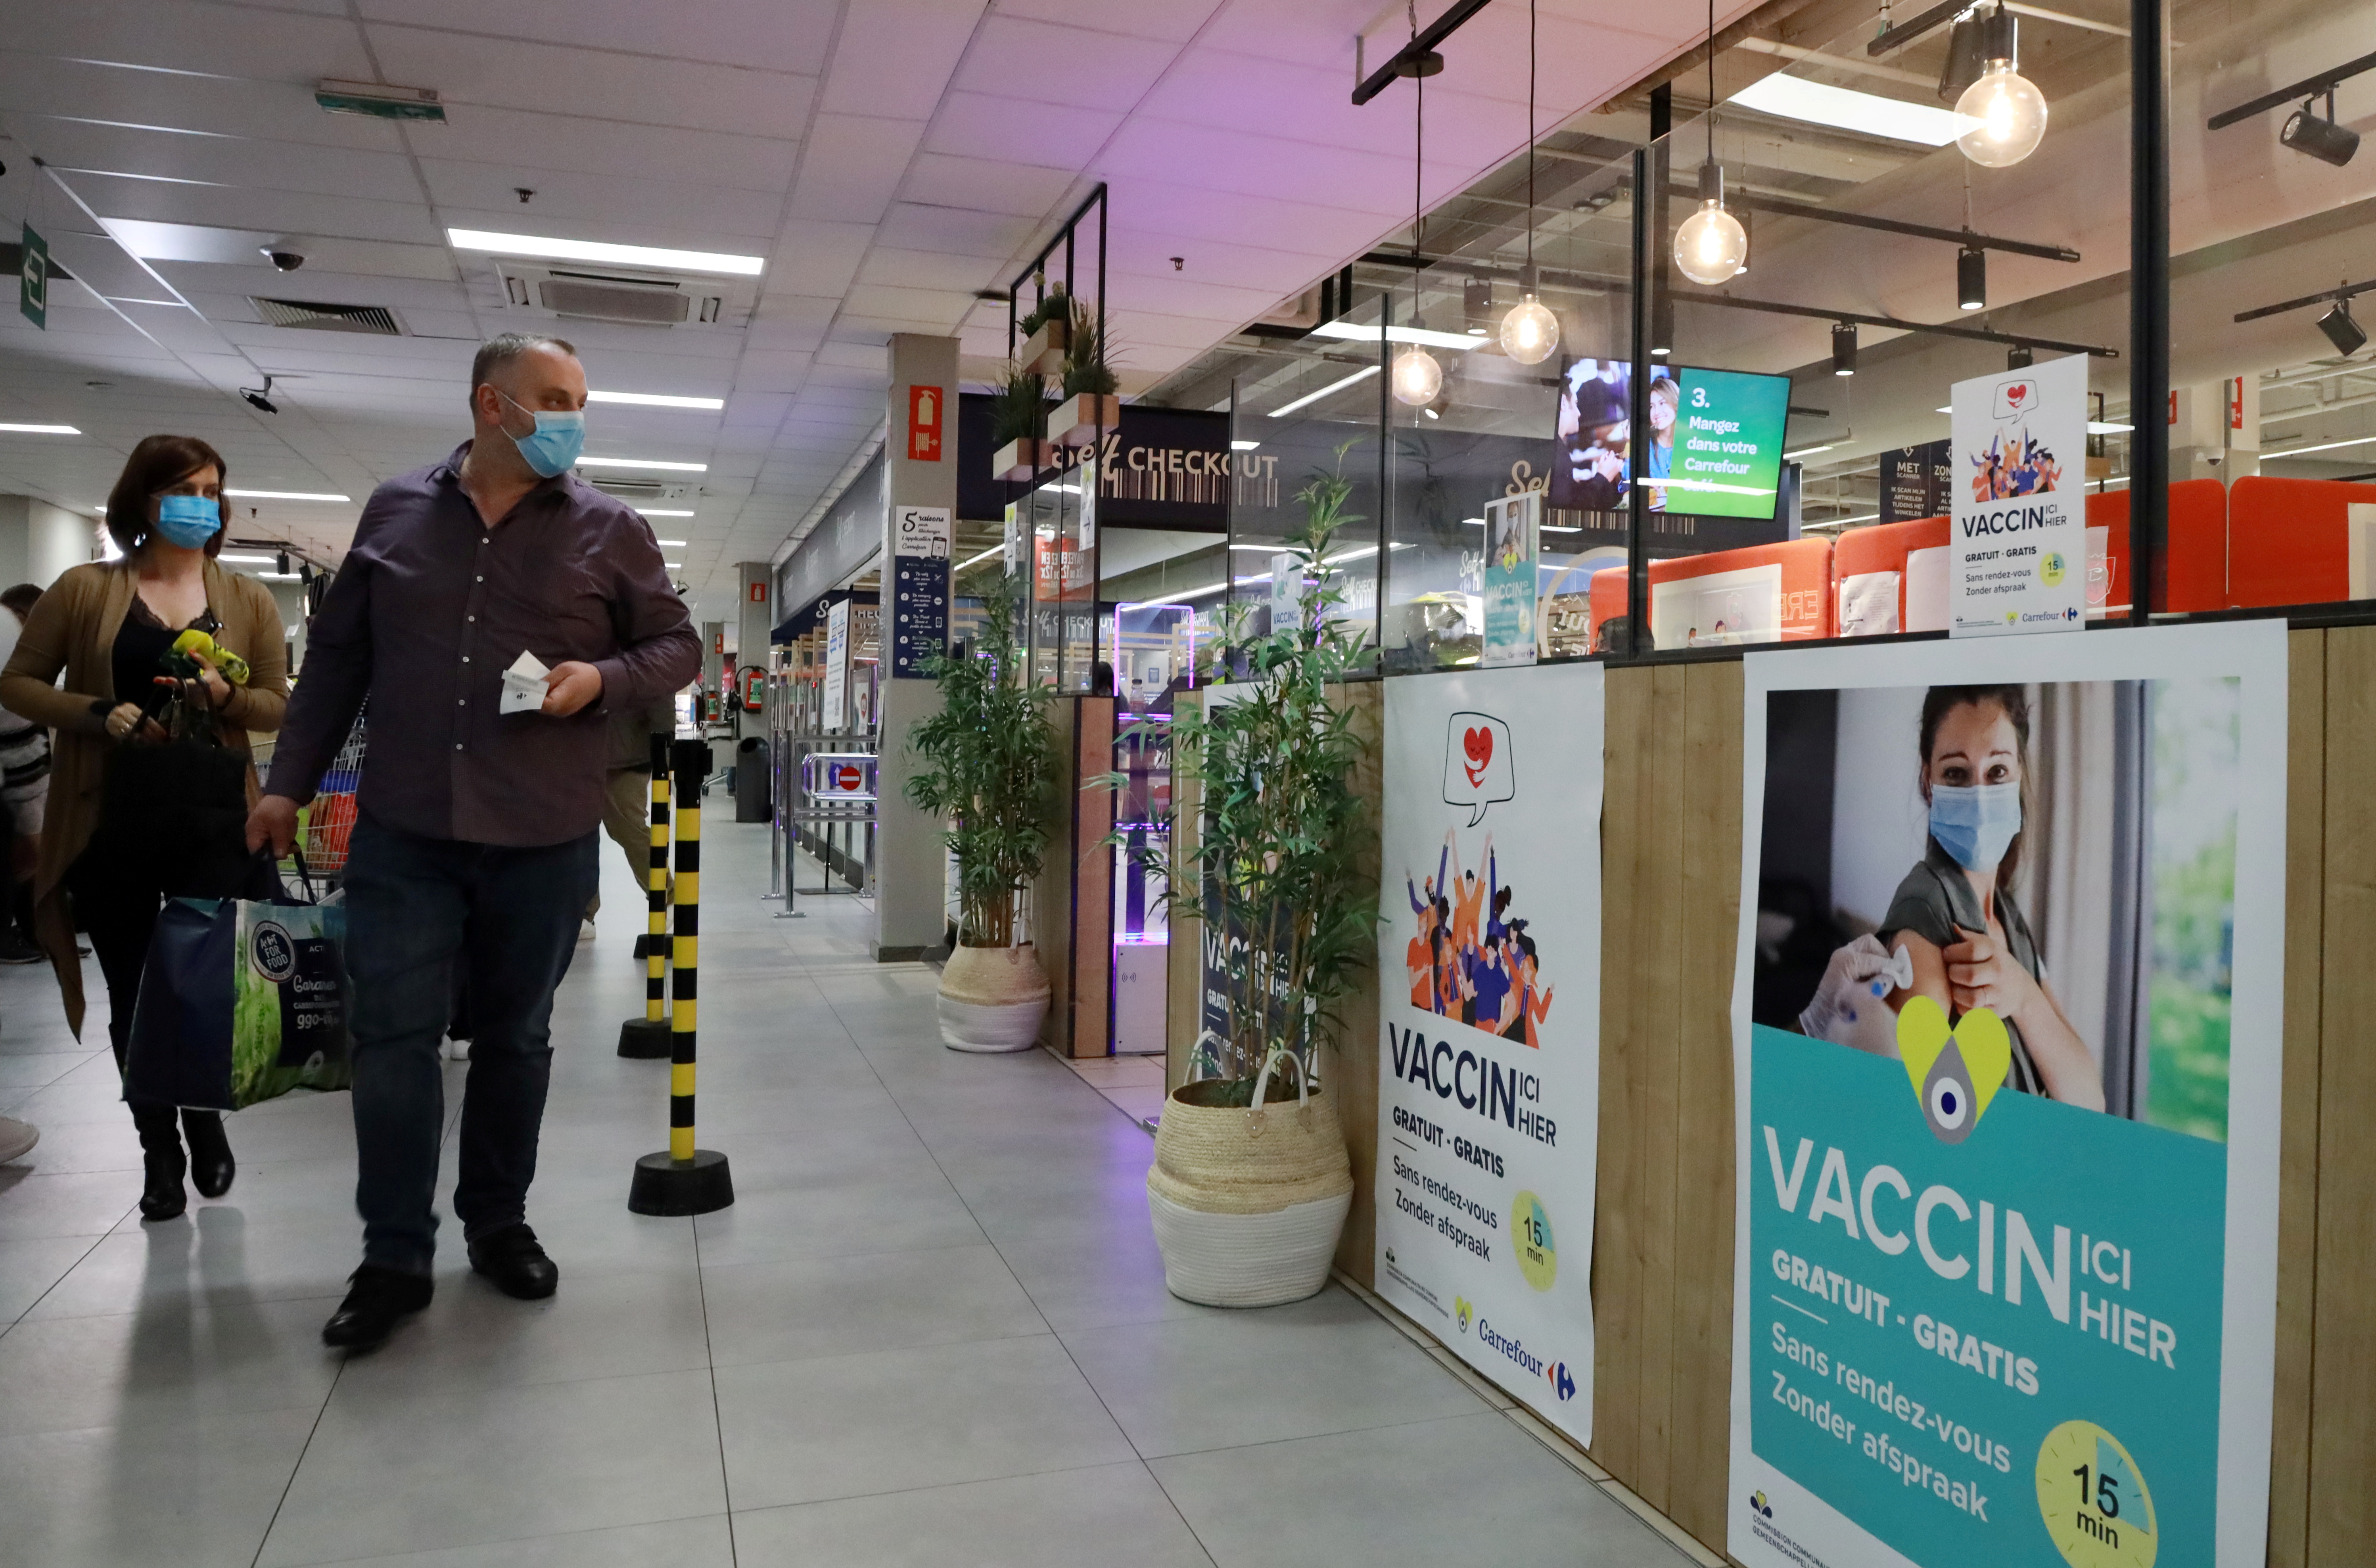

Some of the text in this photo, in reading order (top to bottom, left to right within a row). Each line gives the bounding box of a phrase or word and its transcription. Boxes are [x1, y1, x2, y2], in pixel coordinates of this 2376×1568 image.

[1691, 388, 1710, 408] 3.
[1689, 416, 1740, 435] Mangez
[1687, 437, 1757, 455] dans votre
[1685, 458, 1750, 475] Carrefour
[1897, 462, 1920, 473] MET
[902, 511, 917, 532] 5
[1962, 504, 2057, 538] VACCIN ICI
[2045, 516, 2067, 527] HIER
[1966, 546, 2037, 562] GRATUIT GRATIS
[1966, 569, 2031, 582] Sans rendez-vous
[2048, 560, 2058, 571] 15
[1356, 578, 1377, 594] CHECK
[1486, 581, 1523, 600] VACCIN
[1966, 583, 2026, 596] Zonder afspraak
[1273, 611, 1293, 625] VACCIN
[2023, 611, 2059, 622] Carrefour
[265, 946, 282, 958] FOR
[267, 954, 289, 969] FOOD
[1389, 1022, 1540, 1129] VACCIN ICI
[1518, 1108, 1557, 1147] HIER
[1393, 1106, 1504, 1178] GRATUIT GRATIS
[1394, 1155, 1497, 1229] Sans rendez-vous
[1395, 1188, 1490, 1262] Zonder afspraak
[1525, 1216, 1543, 1247] 15
[1763, 1125, 2131, 1324] VACCIN ICI
[1527, 1246, 1544, 1266] min
[1772, 1249, 2039, 1396] GRATUIT GRATIS
[2080, 1291, 2177, 1369] HIER
[1479, 1319, 1543, 1378] Carrefour
[1772, 1321, 2011, 1473] Sans rendez-vous
[1772, 1370, 1988, 1522] Zonder afspraak
[2073, 1463, 2119, 1518] 15
[1753, 1514, 1791, 1547] COMMISSION
[2077, 1509, 2119, 1550] min
